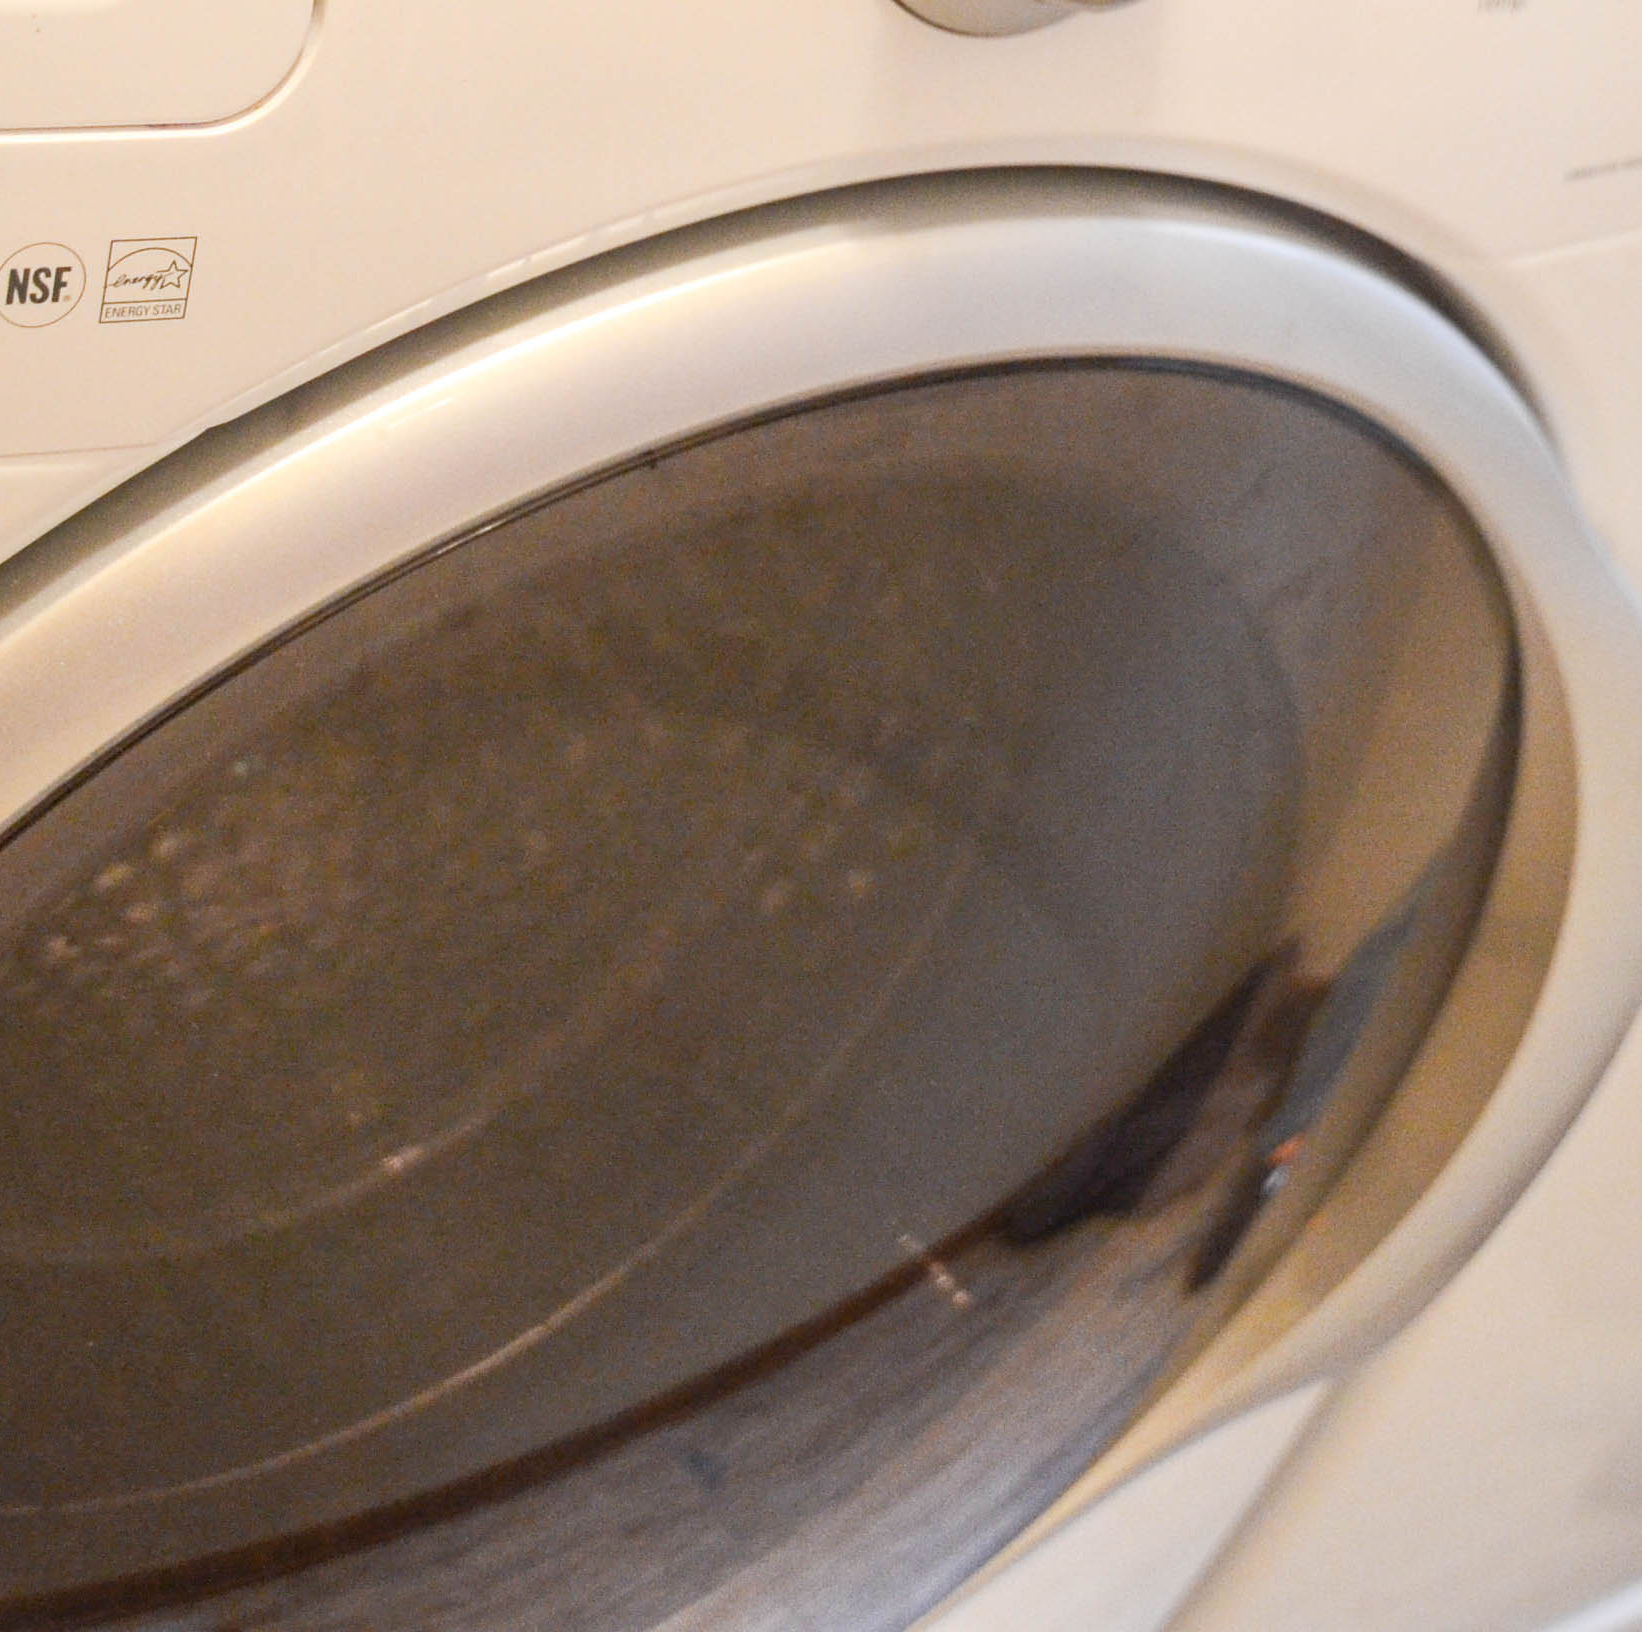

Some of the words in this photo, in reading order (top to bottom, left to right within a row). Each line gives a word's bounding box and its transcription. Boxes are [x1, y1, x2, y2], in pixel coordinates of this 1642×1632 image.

[5, 266, 73, 306] NSF
[104, 304, 151, 319] ENERGY
[151, 303, 183, 317] STAR
